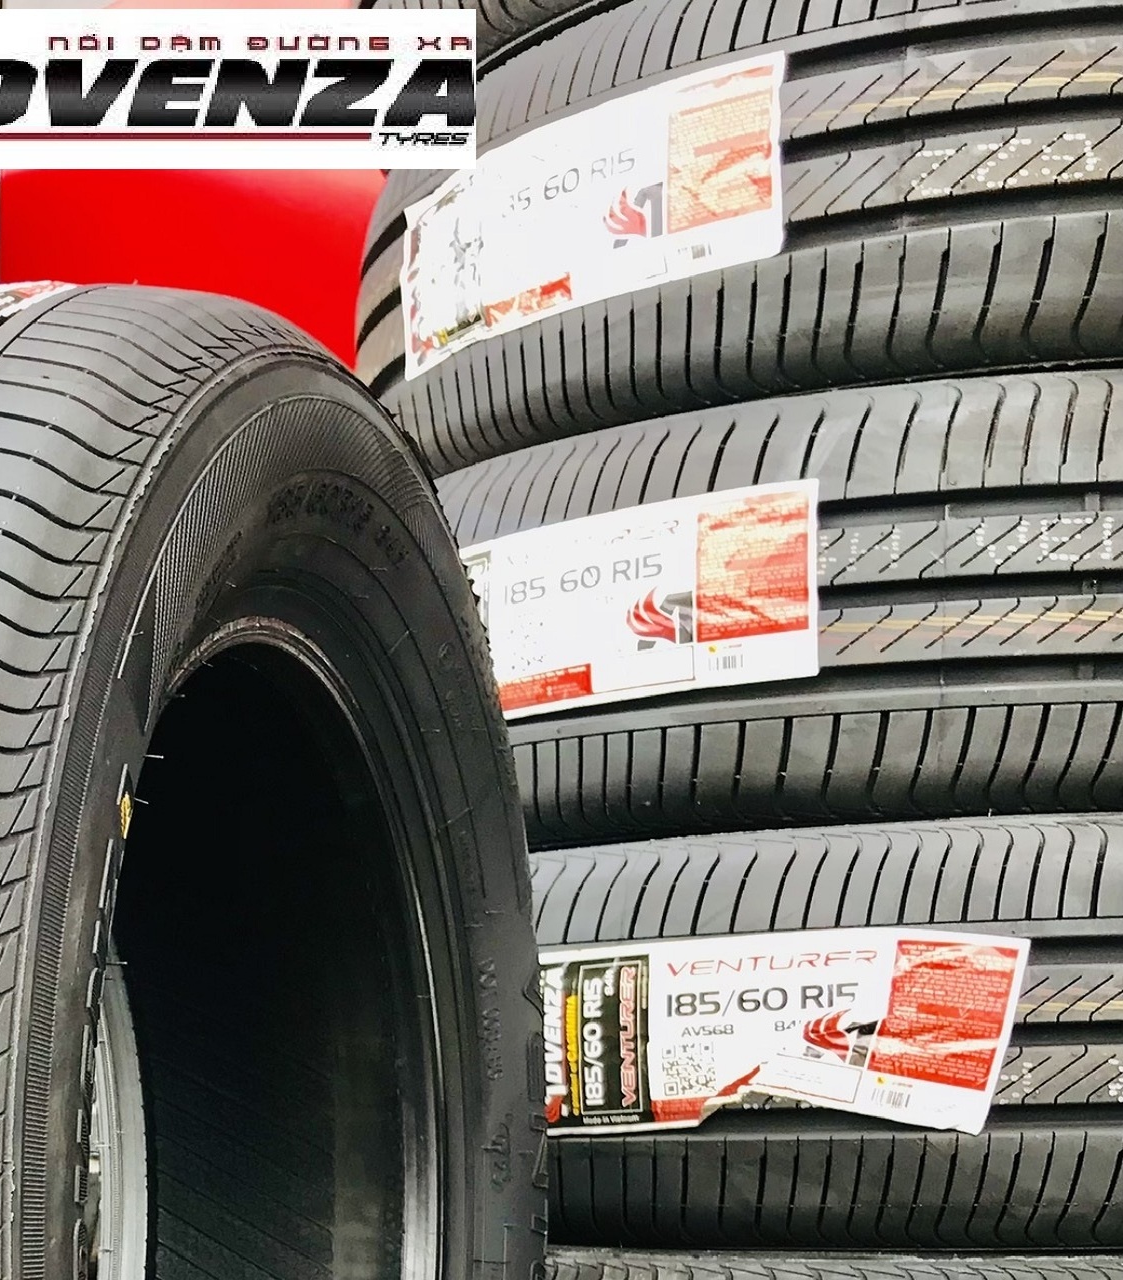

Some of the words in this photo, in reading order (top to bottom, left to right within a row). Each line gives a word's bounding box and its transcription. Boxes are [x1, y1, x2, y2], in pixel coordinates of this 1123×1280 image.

[611, 552, 663, 584] R15
[667, 950, 878, 977] VENTURER
[583, 977, 604, 1019] R15
[666, 987, 789, 1018] 185/60
[800, 982, 860, 1010] R15
[620, 966, 637, 1108] VENTURER
[583, 1021, 605, 1107] 185/60
